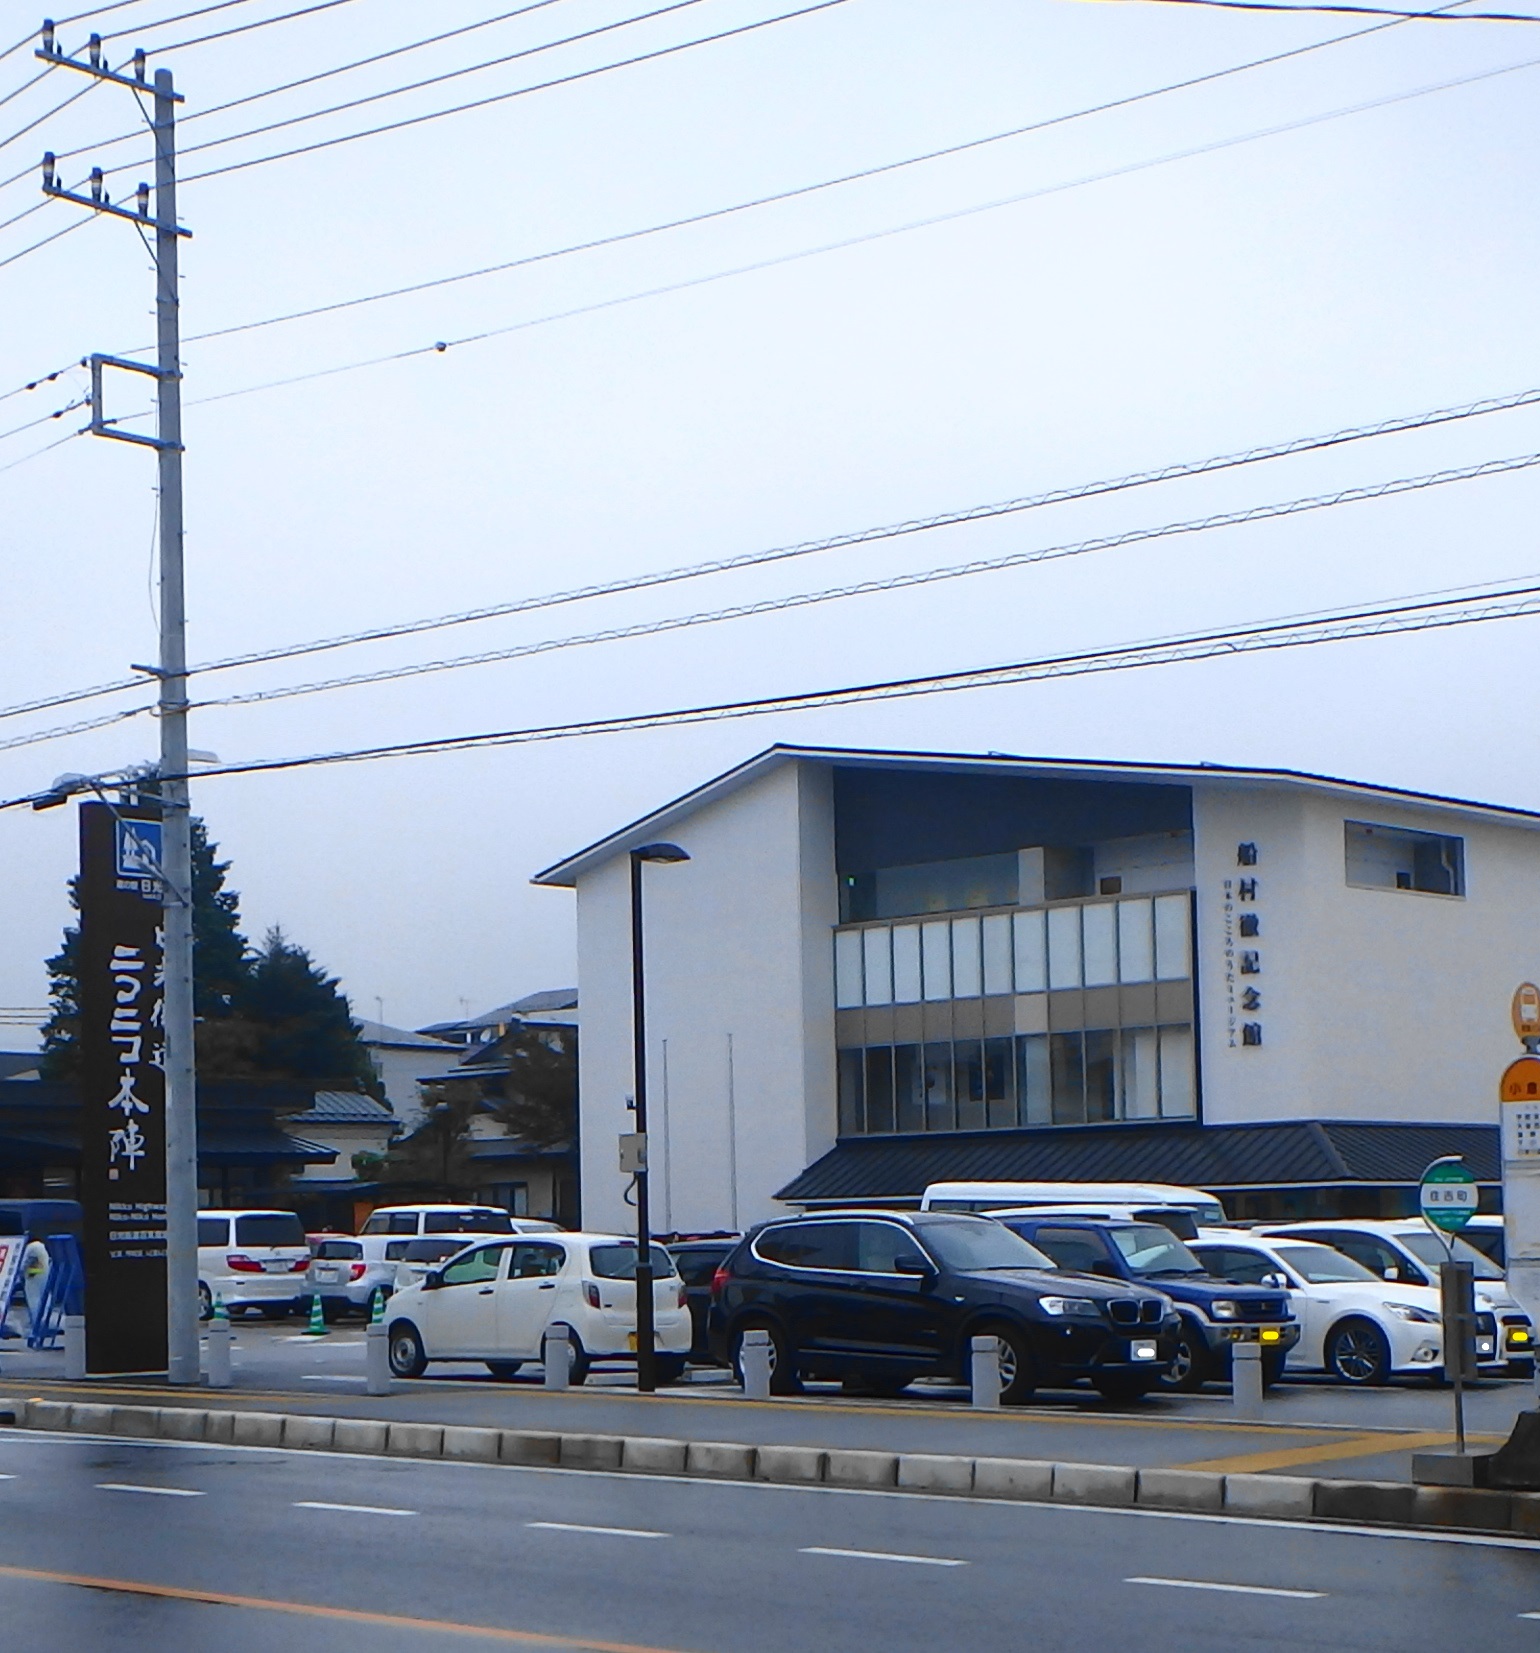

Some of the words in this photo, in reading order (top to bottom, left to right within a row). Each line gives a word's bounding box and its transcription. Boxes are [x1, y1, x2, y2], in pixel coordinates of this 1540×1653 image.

[108, 945, 150, 1170] ニコニコ本陣
[1430, 1190, 1467, 1202] 住吉町
